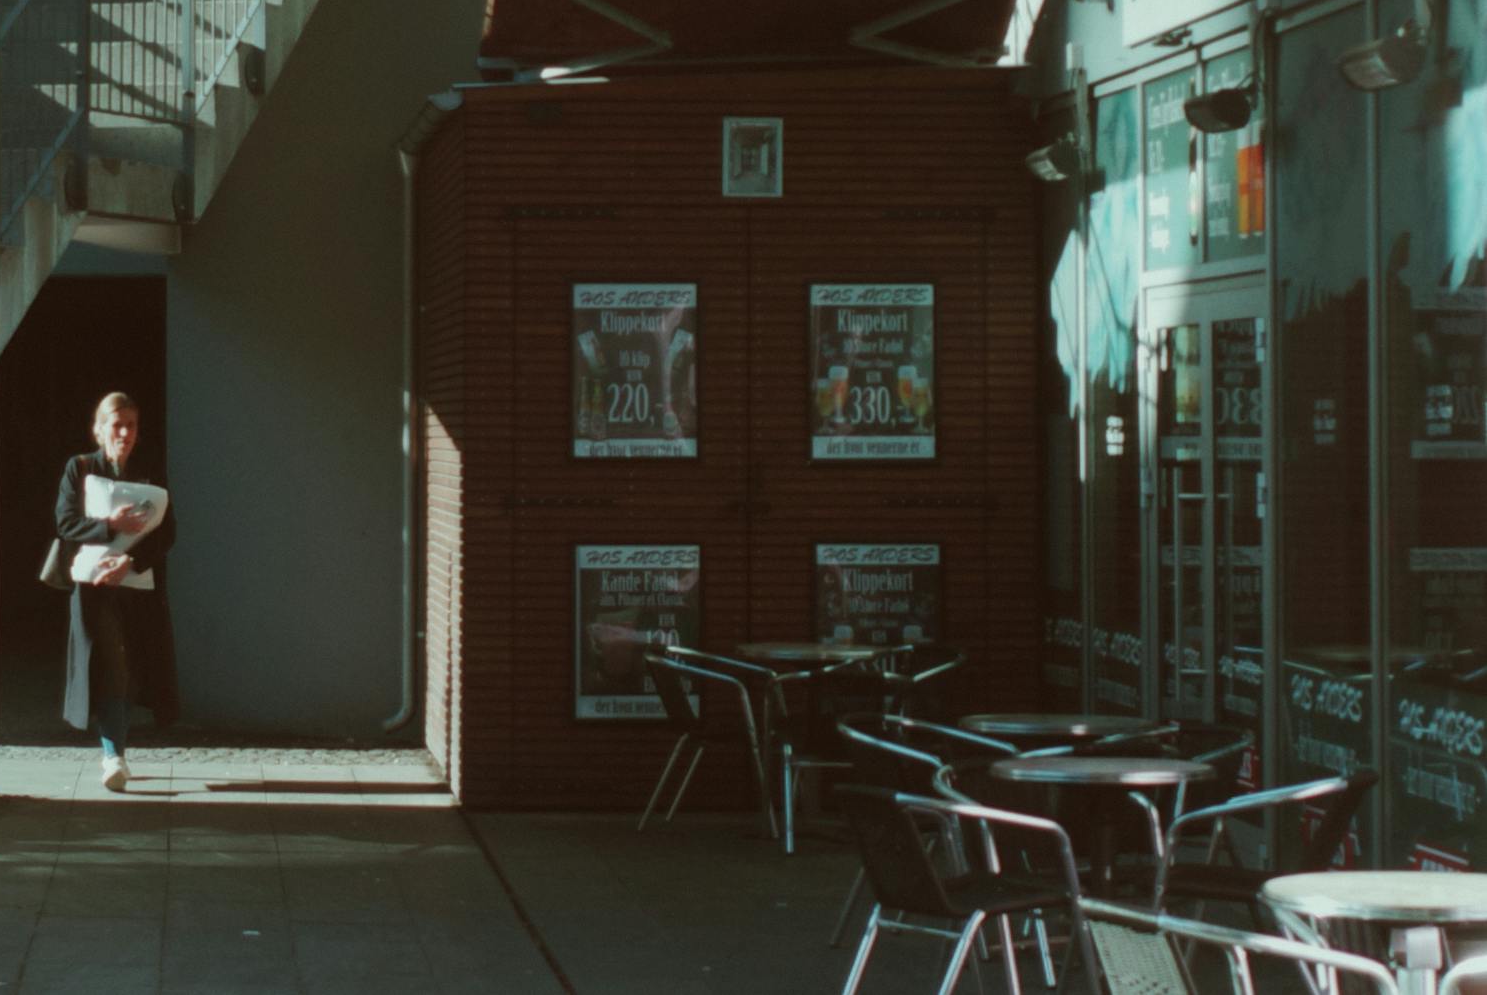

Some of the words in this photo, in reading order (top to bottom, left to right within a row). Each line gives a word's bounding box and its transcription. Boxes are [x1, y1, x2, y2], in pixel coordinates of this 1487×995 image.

[580, 291, 616, 305] HOS
[620, 290, 692, 306] ANDERS
[818, 289, 852, 303] HOS
[856, 288, 929, 303] ANDERS
[600, 310, 667, 334] Klippekort
[837, 309, 908, 334] Klippekort
[585, 551, 622, 564] HOS
[625, 550, 698, 564] ANDERS
[823, 548, 858, 561] HOS
[862, 548, 934, 562] ANDERS
[842, 569, 914, 593] Klippekort
